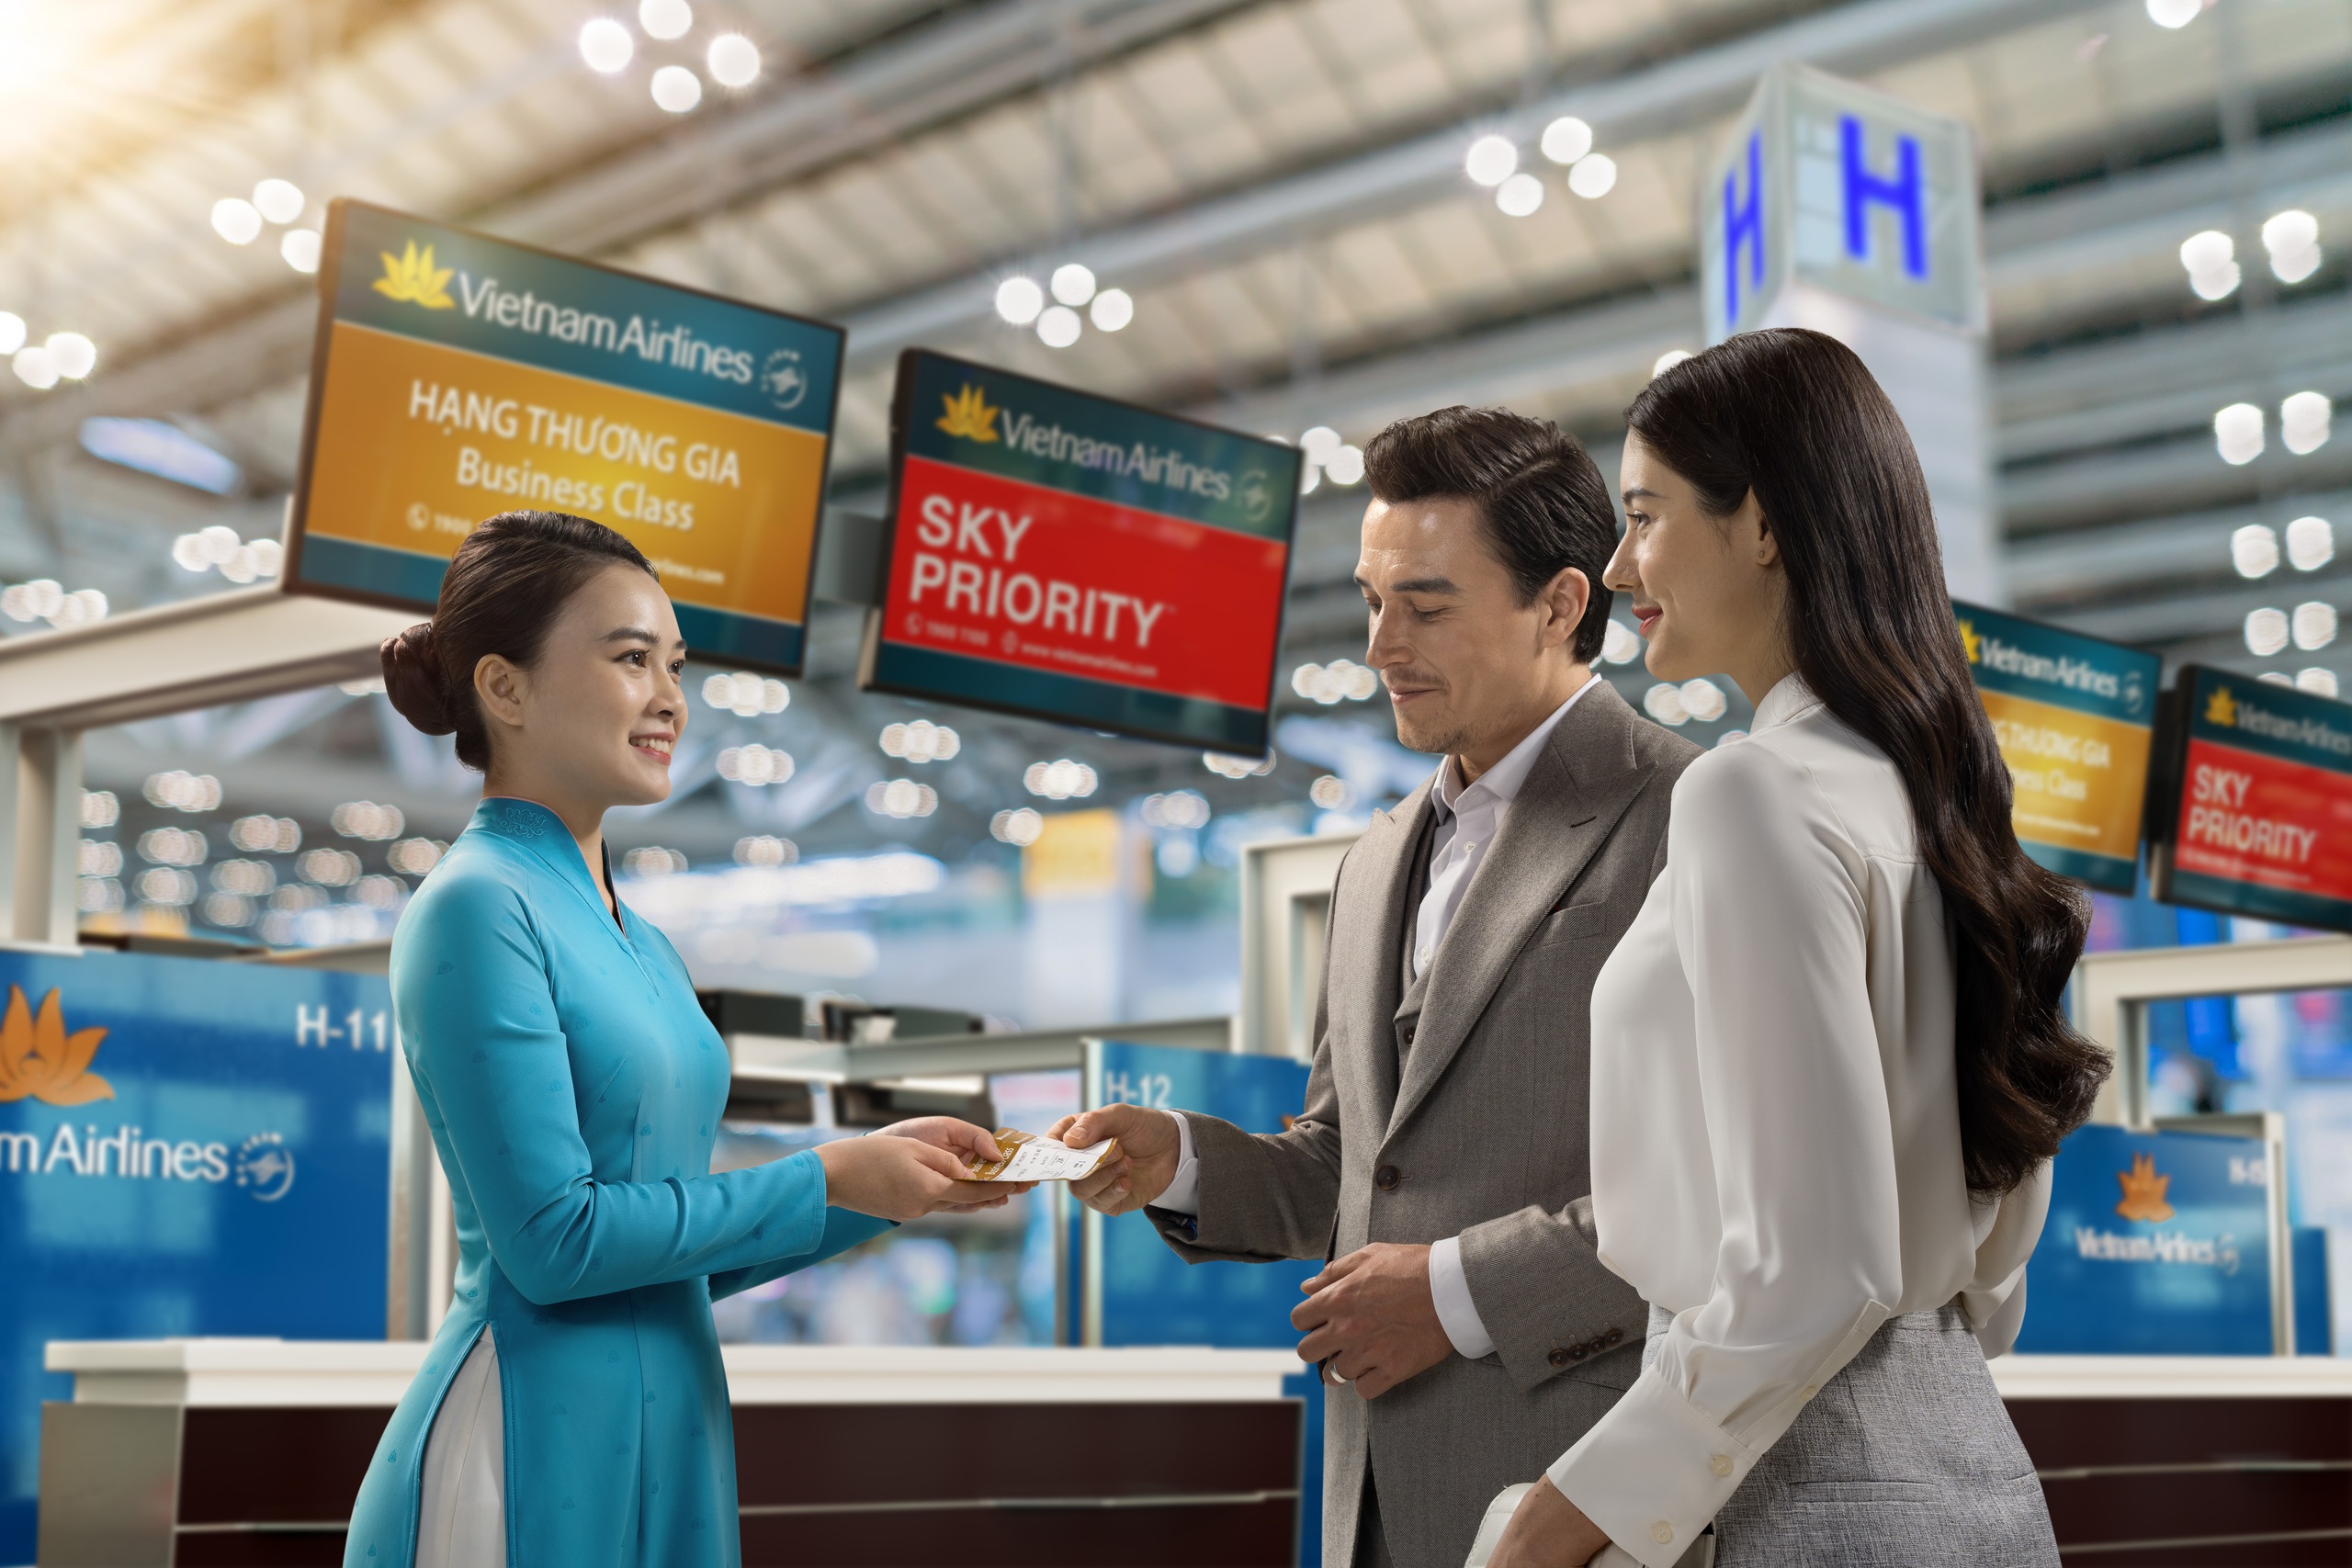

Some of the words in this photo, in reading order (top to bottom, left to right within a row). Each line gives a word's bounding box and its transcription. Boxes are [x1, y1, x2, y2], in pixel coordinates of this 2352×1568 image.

[1724, 127, 1764, 331] H
[1838, 112, 1928, 282] H
[458, 273, 616, 352] Vietnam
[617, 316, 754, 385] Airlines
[409, 380, 518, 437] HẠNG
[526, 402, 677, 473] THƯƠNG
[684, 444, 741, 488] GIA
[1002, 409, 1123, 472] Vietnam
[1125, 443, 1230, 501] Airlines
[457, 447, 605, 513] Business
[613, 481, 695, 531] Class
[917, 495, 1033, 561] SKY
[909, 553, 1164, 649] PRIORITY
[1981, 636, 2057, 683] Vietnam
[2055, 655, 2119, 698] Airlines
[2048, 768, 2087, 801] Class
[2192, 763, 2252, 809] SKY
[2187, 804, 2317, 864] PRIORITY
[296, 1002, 387, 1053] H-11
[1106, 1070, 1171, 1109] H-12
[44, 1122, 230, 1182] Airlines
